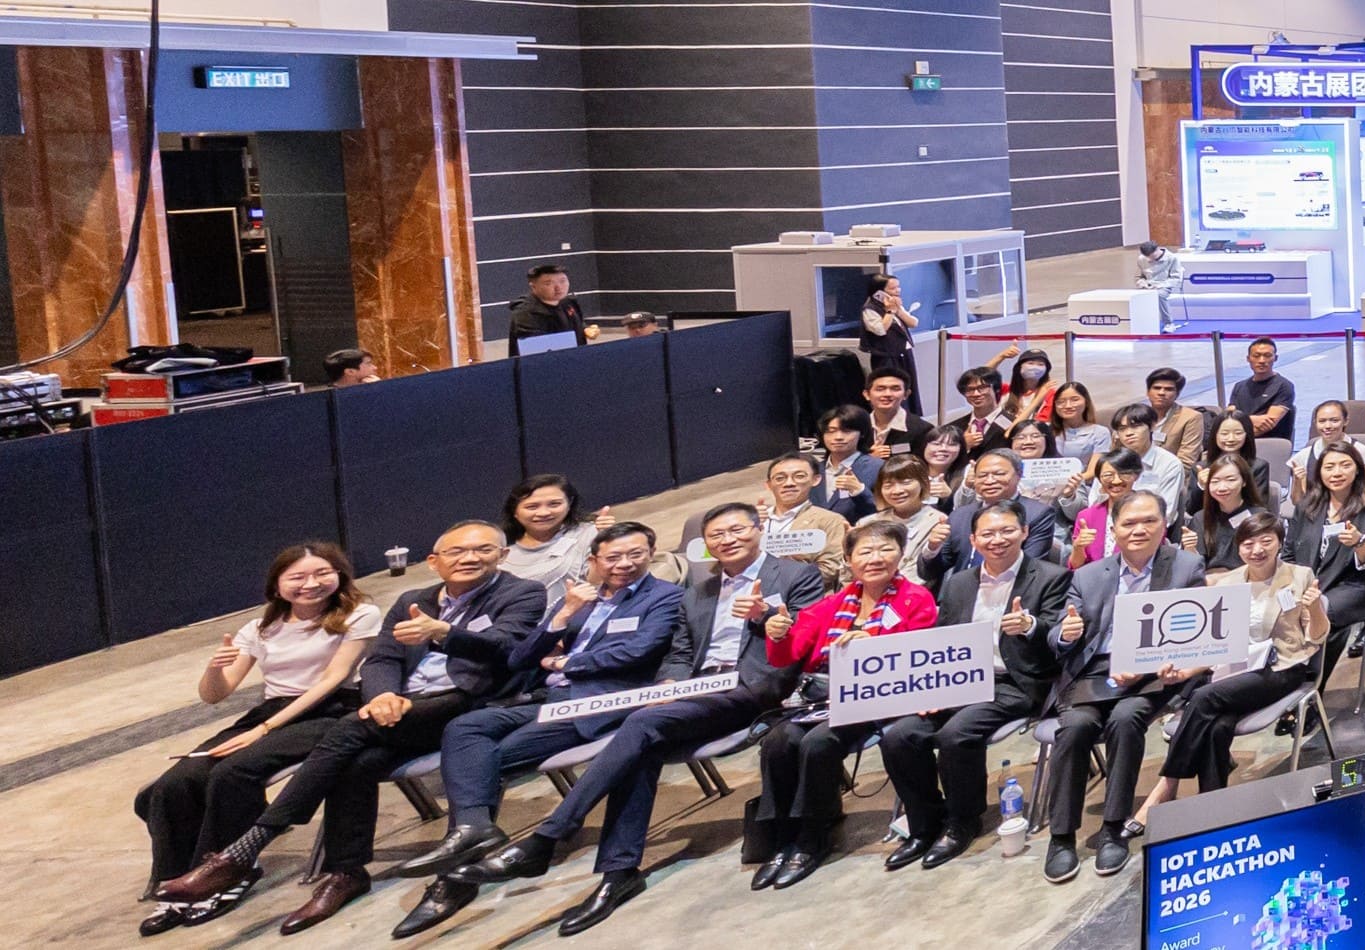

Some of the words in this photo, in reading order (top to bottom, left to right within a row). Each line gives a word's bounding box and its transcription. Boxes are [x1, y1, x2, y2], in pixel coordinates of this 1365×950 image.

[212, 71, 250, 87] EXIT
[254, 71, 285, 87] 出口
[853, 652, 902, 677] IOT
[910, 646, 972, 668] Data
[1135, 655, 1164, 663] Industry
[1168, 652, 1198, 661] Advisory
[550, 702, 583, 717] IOT
[590, 696, 631, 710] Data
[638, 678, 732, 702] Hackathon
[840, 668, 985, 703] Hacakthon
[1161, 850, 1198, 873] IOT
[1203, 834, 1261, 862] DATA
[1161, 845, 1295, 895] HACKATHON
[1160, 889, 1211, 917] 2026
[1161, 932, 1200, 950] Award
